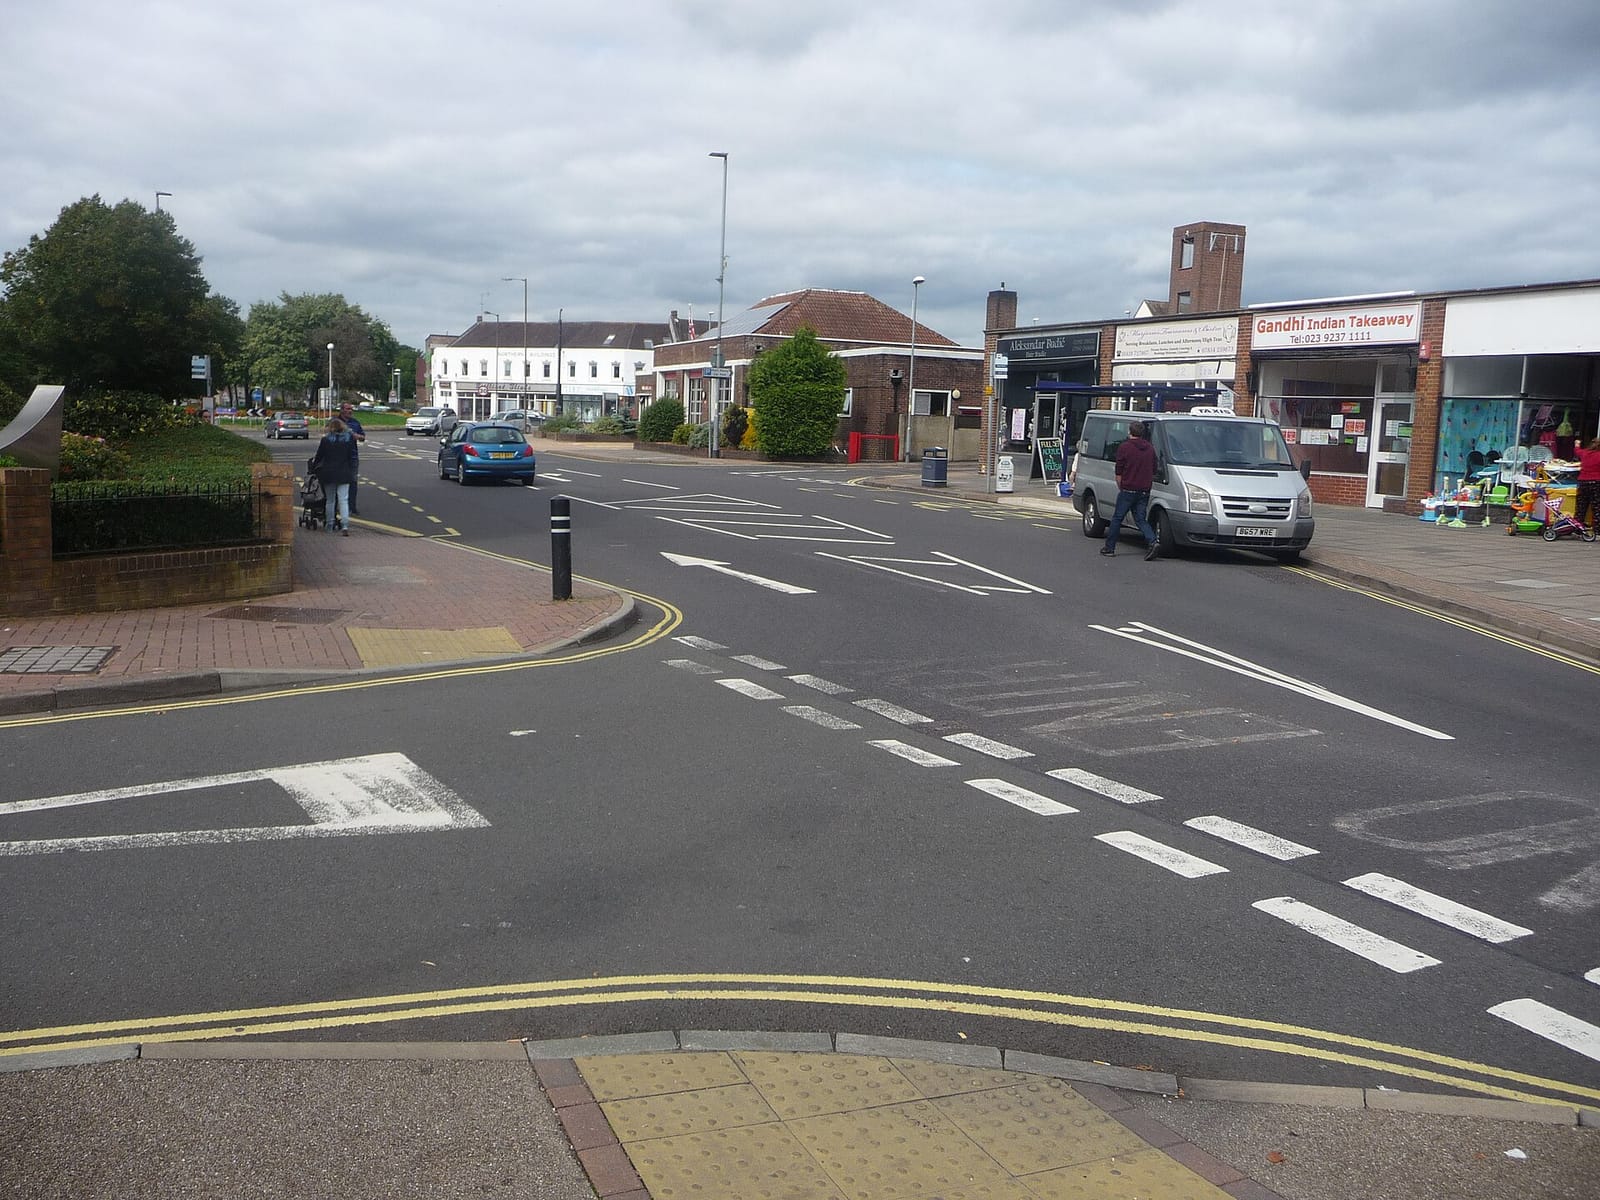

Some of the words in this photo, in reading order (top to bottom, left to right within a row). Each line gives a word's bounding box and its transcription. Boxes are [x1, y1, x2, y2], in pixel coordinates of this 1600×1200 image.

[1257, 316, 1304, 334] Gandhi
[1307, 318, 1345, 331] Indian
[1349, 313, 1414, 328] Takeaway
[1290, 334, 1321, 344] Tel:023
[1324, 333, 1346, 343] 9237
[1349, 331, 1371, 341] 1111
[1198, 408, 1232, 416] TAXIS
